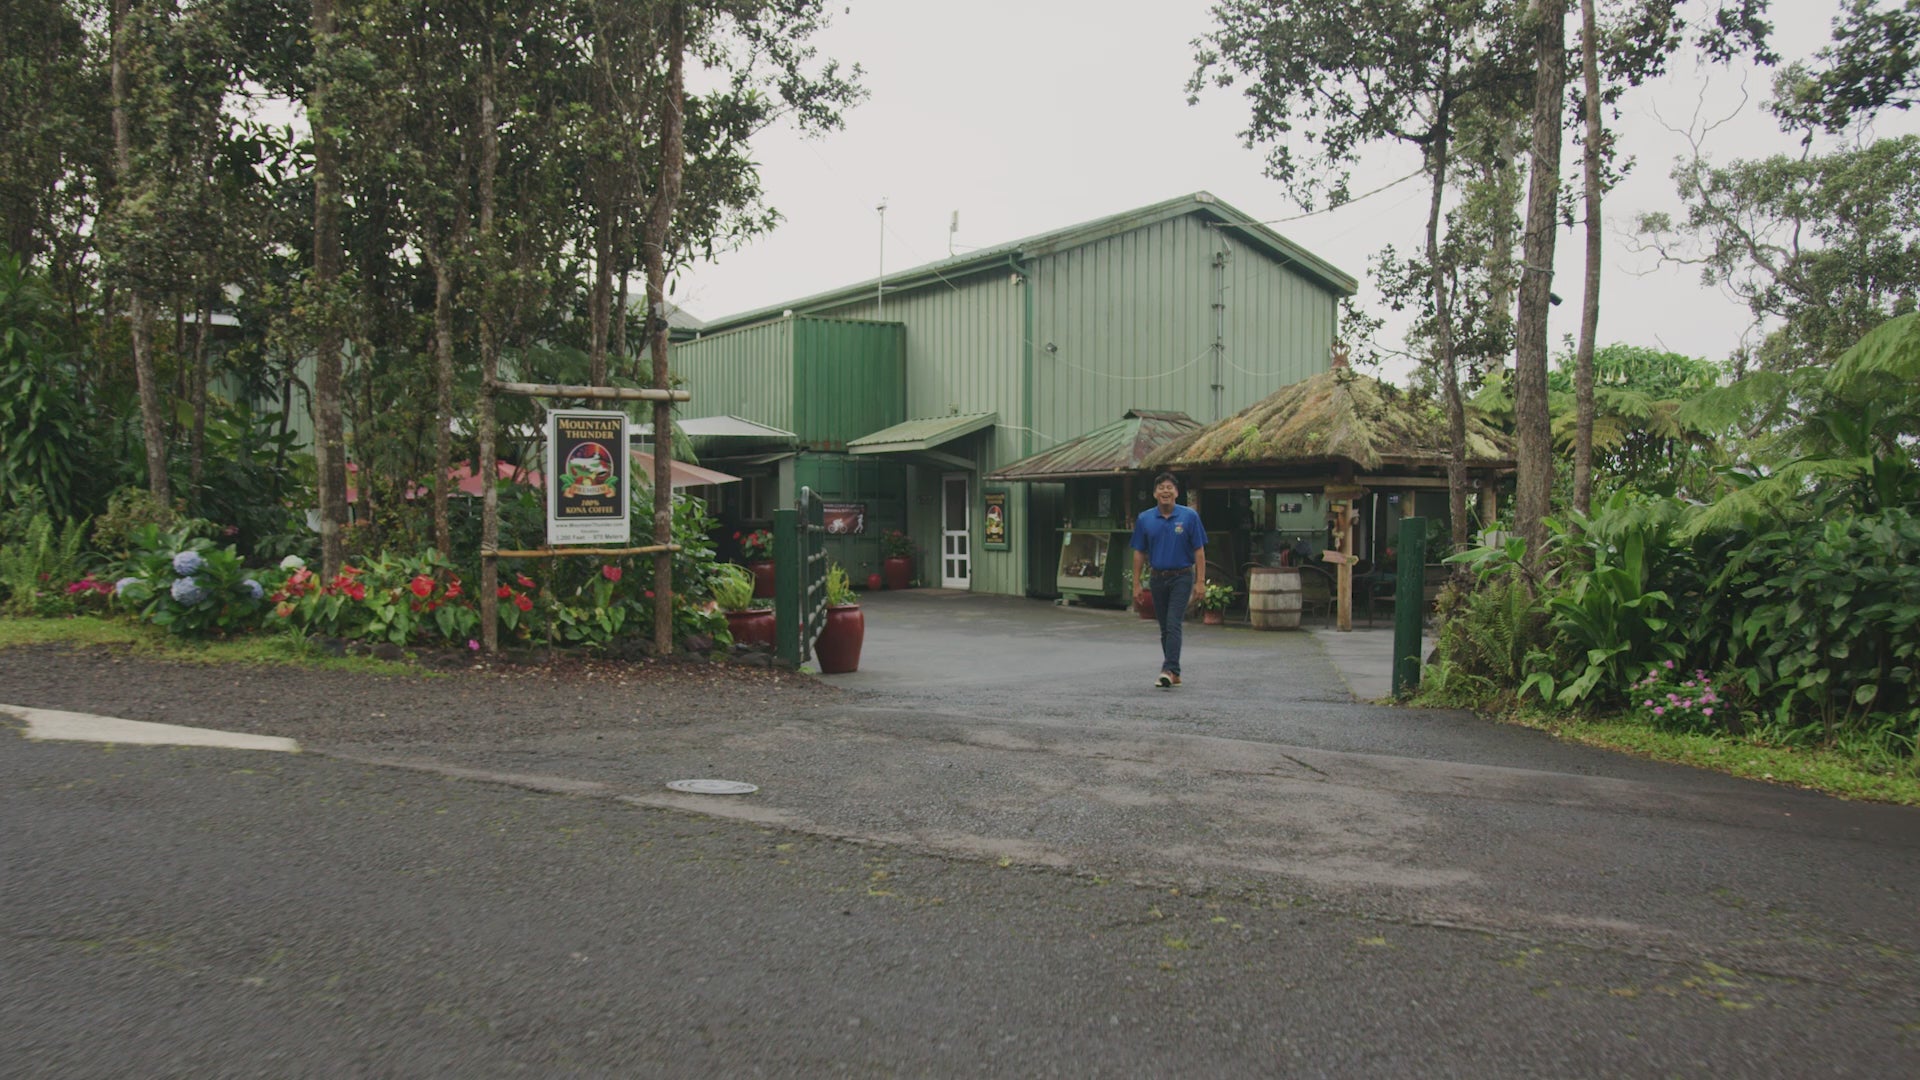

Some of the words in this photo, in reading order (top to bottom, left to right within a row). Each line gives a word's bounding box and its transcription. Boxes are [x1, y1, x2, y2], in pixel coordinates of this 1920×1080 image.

[559, 419, 620, 430] MOUNTAIN
[566, 430, 614, 439] THUNDER
[566, 506, 587, 514] KONA
[588, 506, 614, 514] COFFEE
